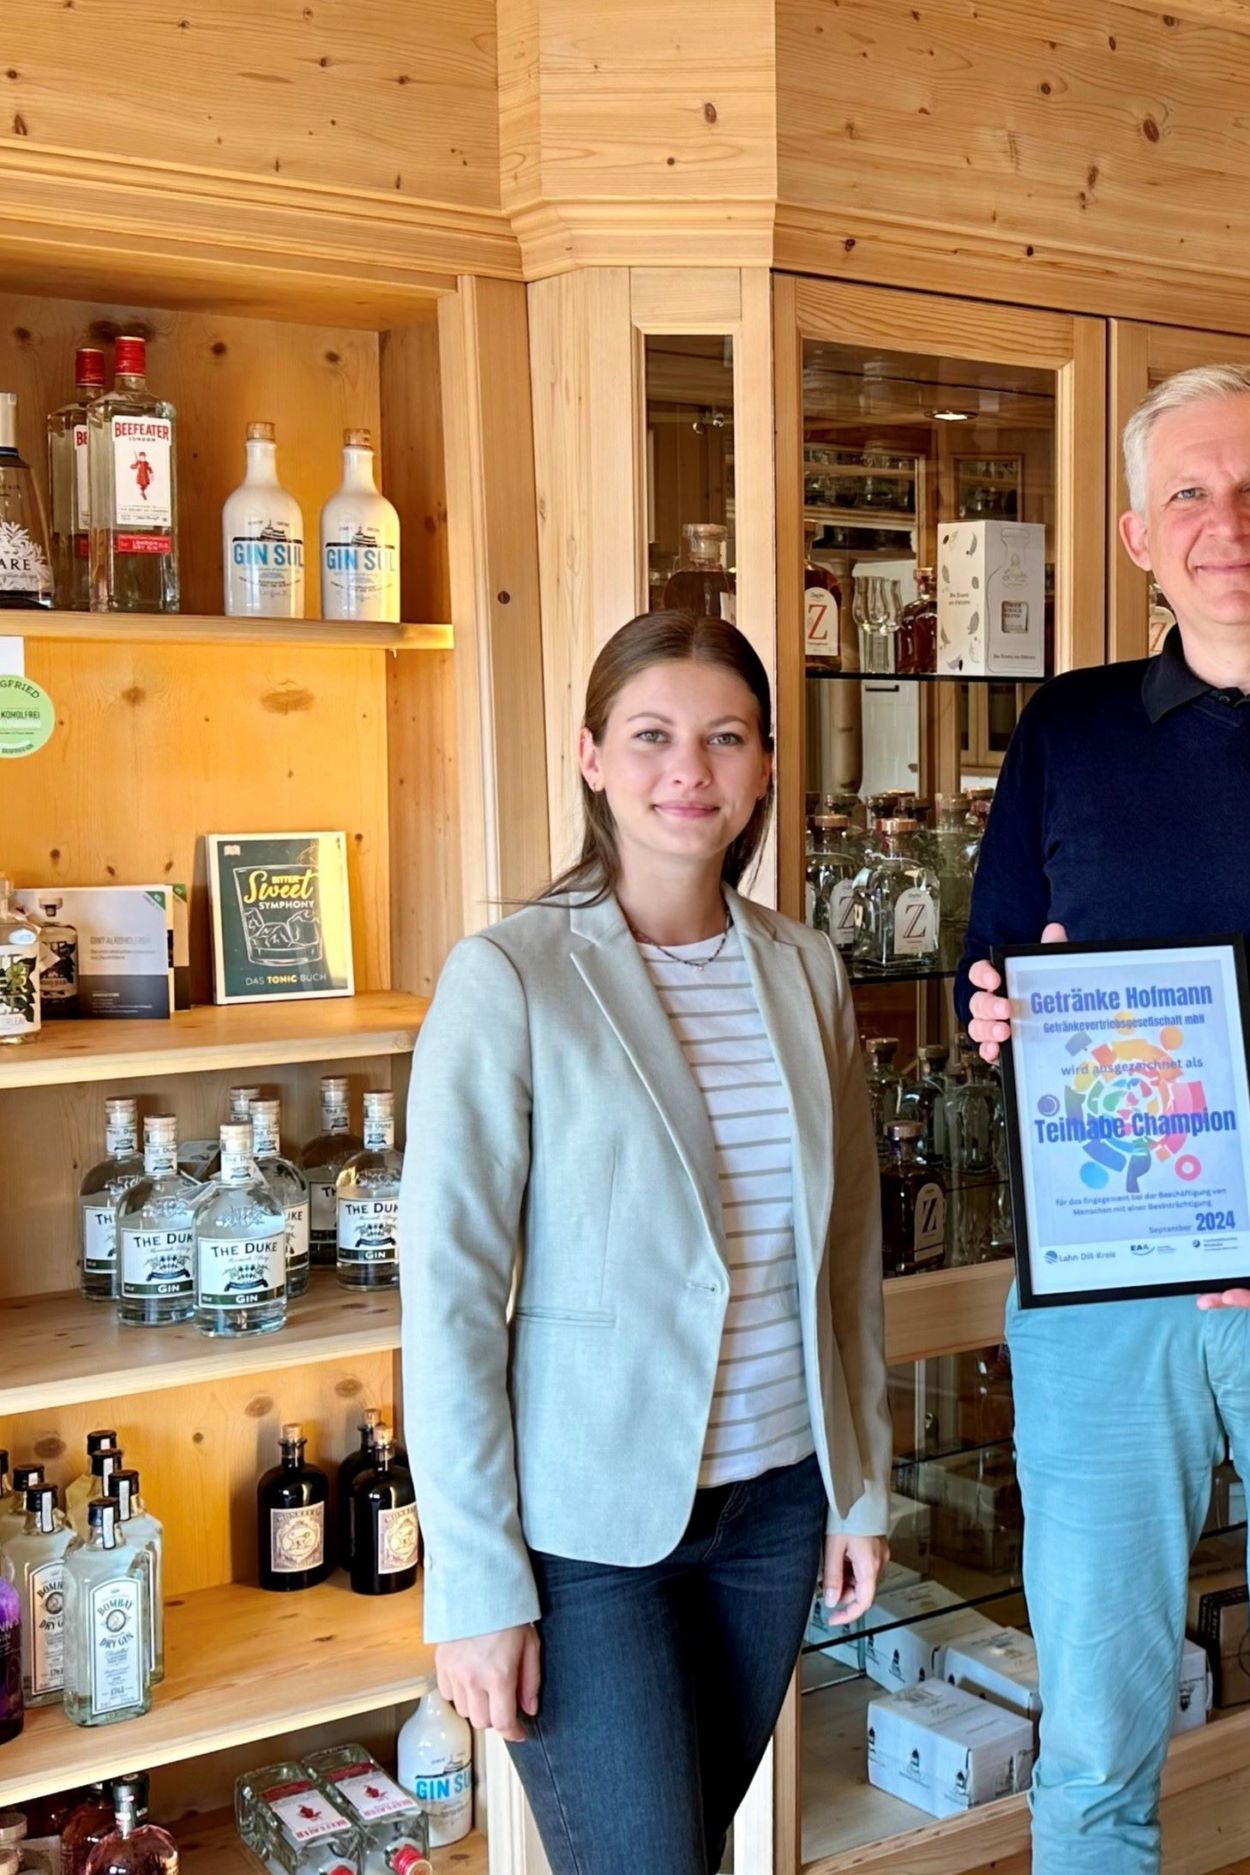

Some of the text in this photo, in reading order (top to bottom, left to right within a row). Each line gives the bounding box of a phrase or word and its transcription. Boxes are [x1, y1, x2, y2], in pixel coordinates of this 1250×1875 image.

[114, 421, 169, 441] BEEFEATER
[233, 543, 268, 565] GIN
[326, 548, 358, 571] GIN
[808, 604, 828, 640] Z
[0, 679, 40, 699] GFRIED
[0, 710, 40, 720] KOHOLFREI
[244, 869, 320, 904] Sweet
[258, 900, 315, 911] SYMPHONY
[902, 903, 927, 939] Z
[245, 973, 327, 986] DAS TONIC BUCH
[1030, 985, 1213, 1014] Getränke Hofmann
[1043, 1015, 1182, 1034] Getränkevertriebsgesellschaft
[1061, 1057, 1203, 1077] wird ausgezeichnet als
[1034, 1107, 1237, 1143] Teilhabe Champion
[322, 1186, 337, 1198] TH
[1084, 1195, 1130, 1206] Engagement
[345, 1202, 398, 1215] THE DUK
[921, 1197, 937, 1234] Z
[1073, 1207, 1112, 1216] Menschen
[1113, 1205, 1127, 1213] mit
[95, 1213, 113, 1225] TH
[1149, 1210, 1236, 1235] September 2024
[133, 1236, 161, 1249] THE
[166, 1233, 193, 1245] DUK
[210, 1242, 278, 1258] THE DUKE
[365, 1251, 386, 1260] GIN
[157, 1285, 180, 1293] GIN
[235, 1294, 258, 1304] GIN
[97, 1598, 133, 1616] BOMBAY
[99, 1632, 134, 1649] DRY GIN
[416, 1770, 471, 1800] GIN SU
